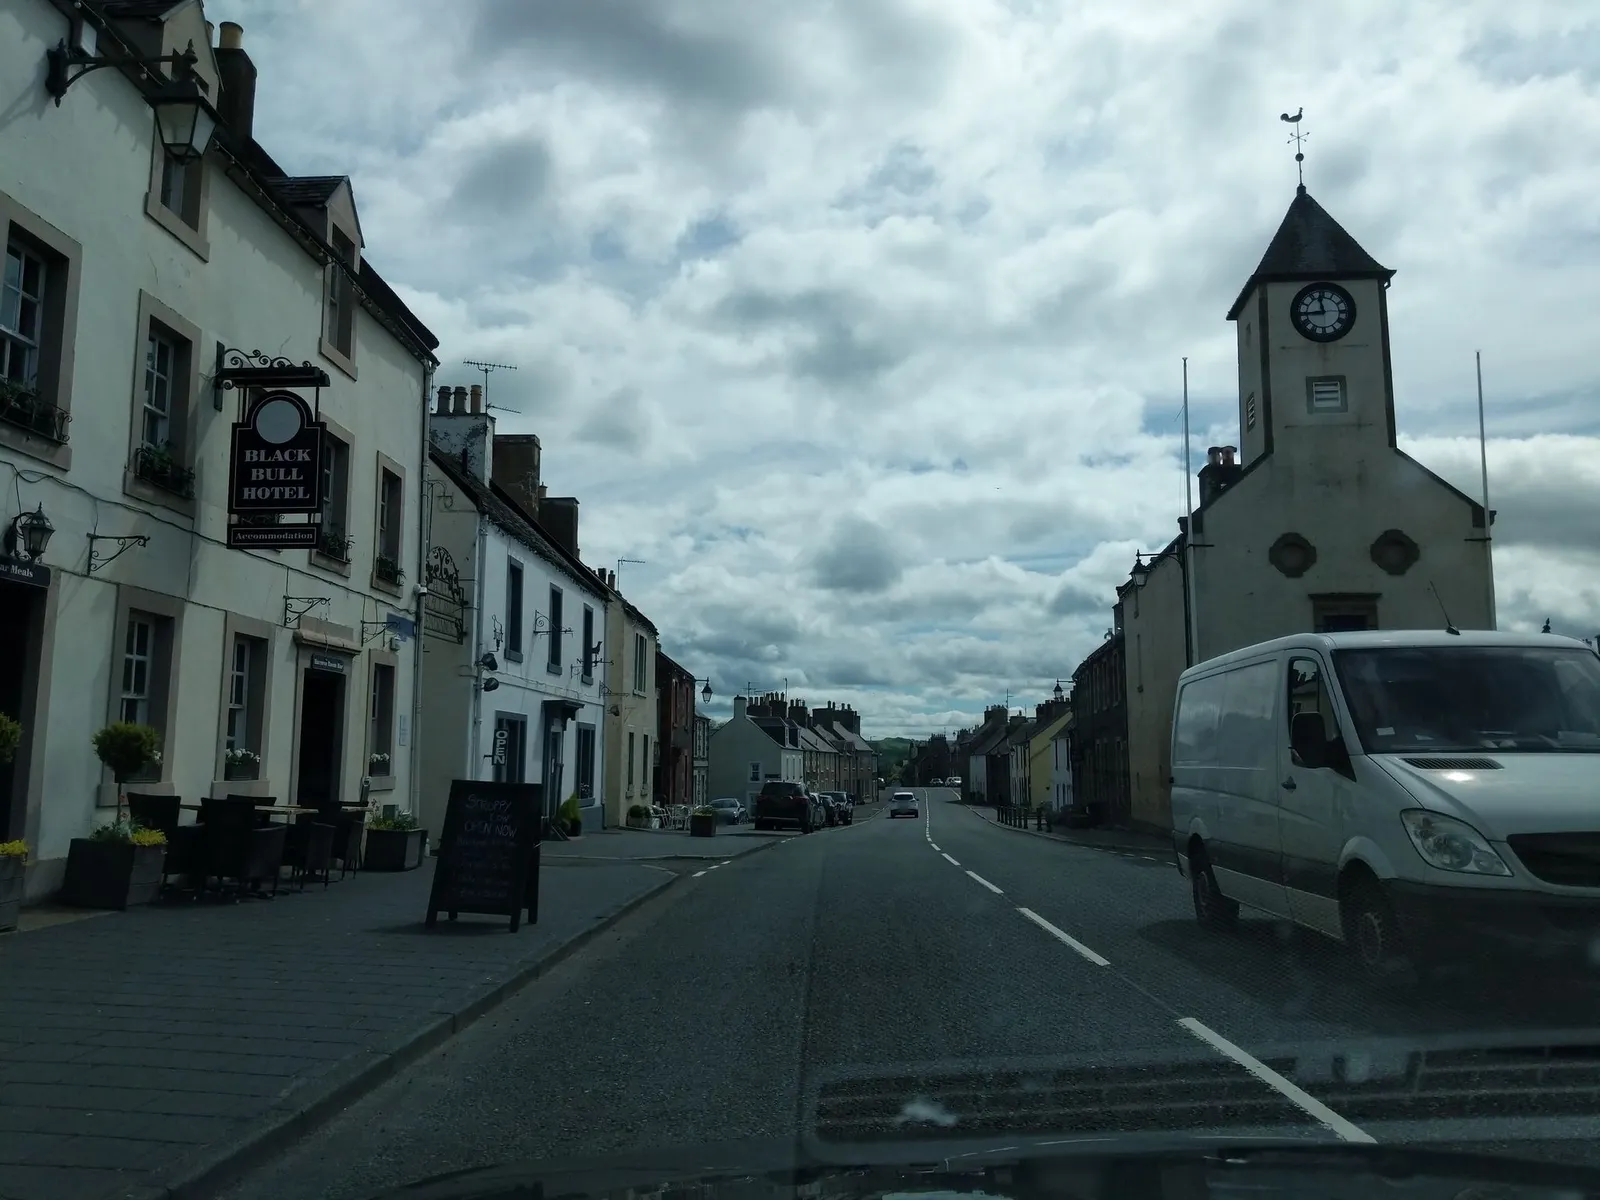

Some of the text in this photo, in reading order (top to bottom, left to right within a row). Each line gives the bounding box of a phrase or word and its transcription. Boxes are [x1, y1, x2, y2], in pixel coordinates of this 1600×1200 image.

[244, 449, 312, 462] BLACK
[250, 468, 304, 481] BULL
[242, 486, 310, 500] HOTEL
[235, 532, 313, 540] Accommodation
[10, 564, 33, 577] Meals
[493, 730, 508, 764] OPEN
[495, 823, 518, 838] NOW
